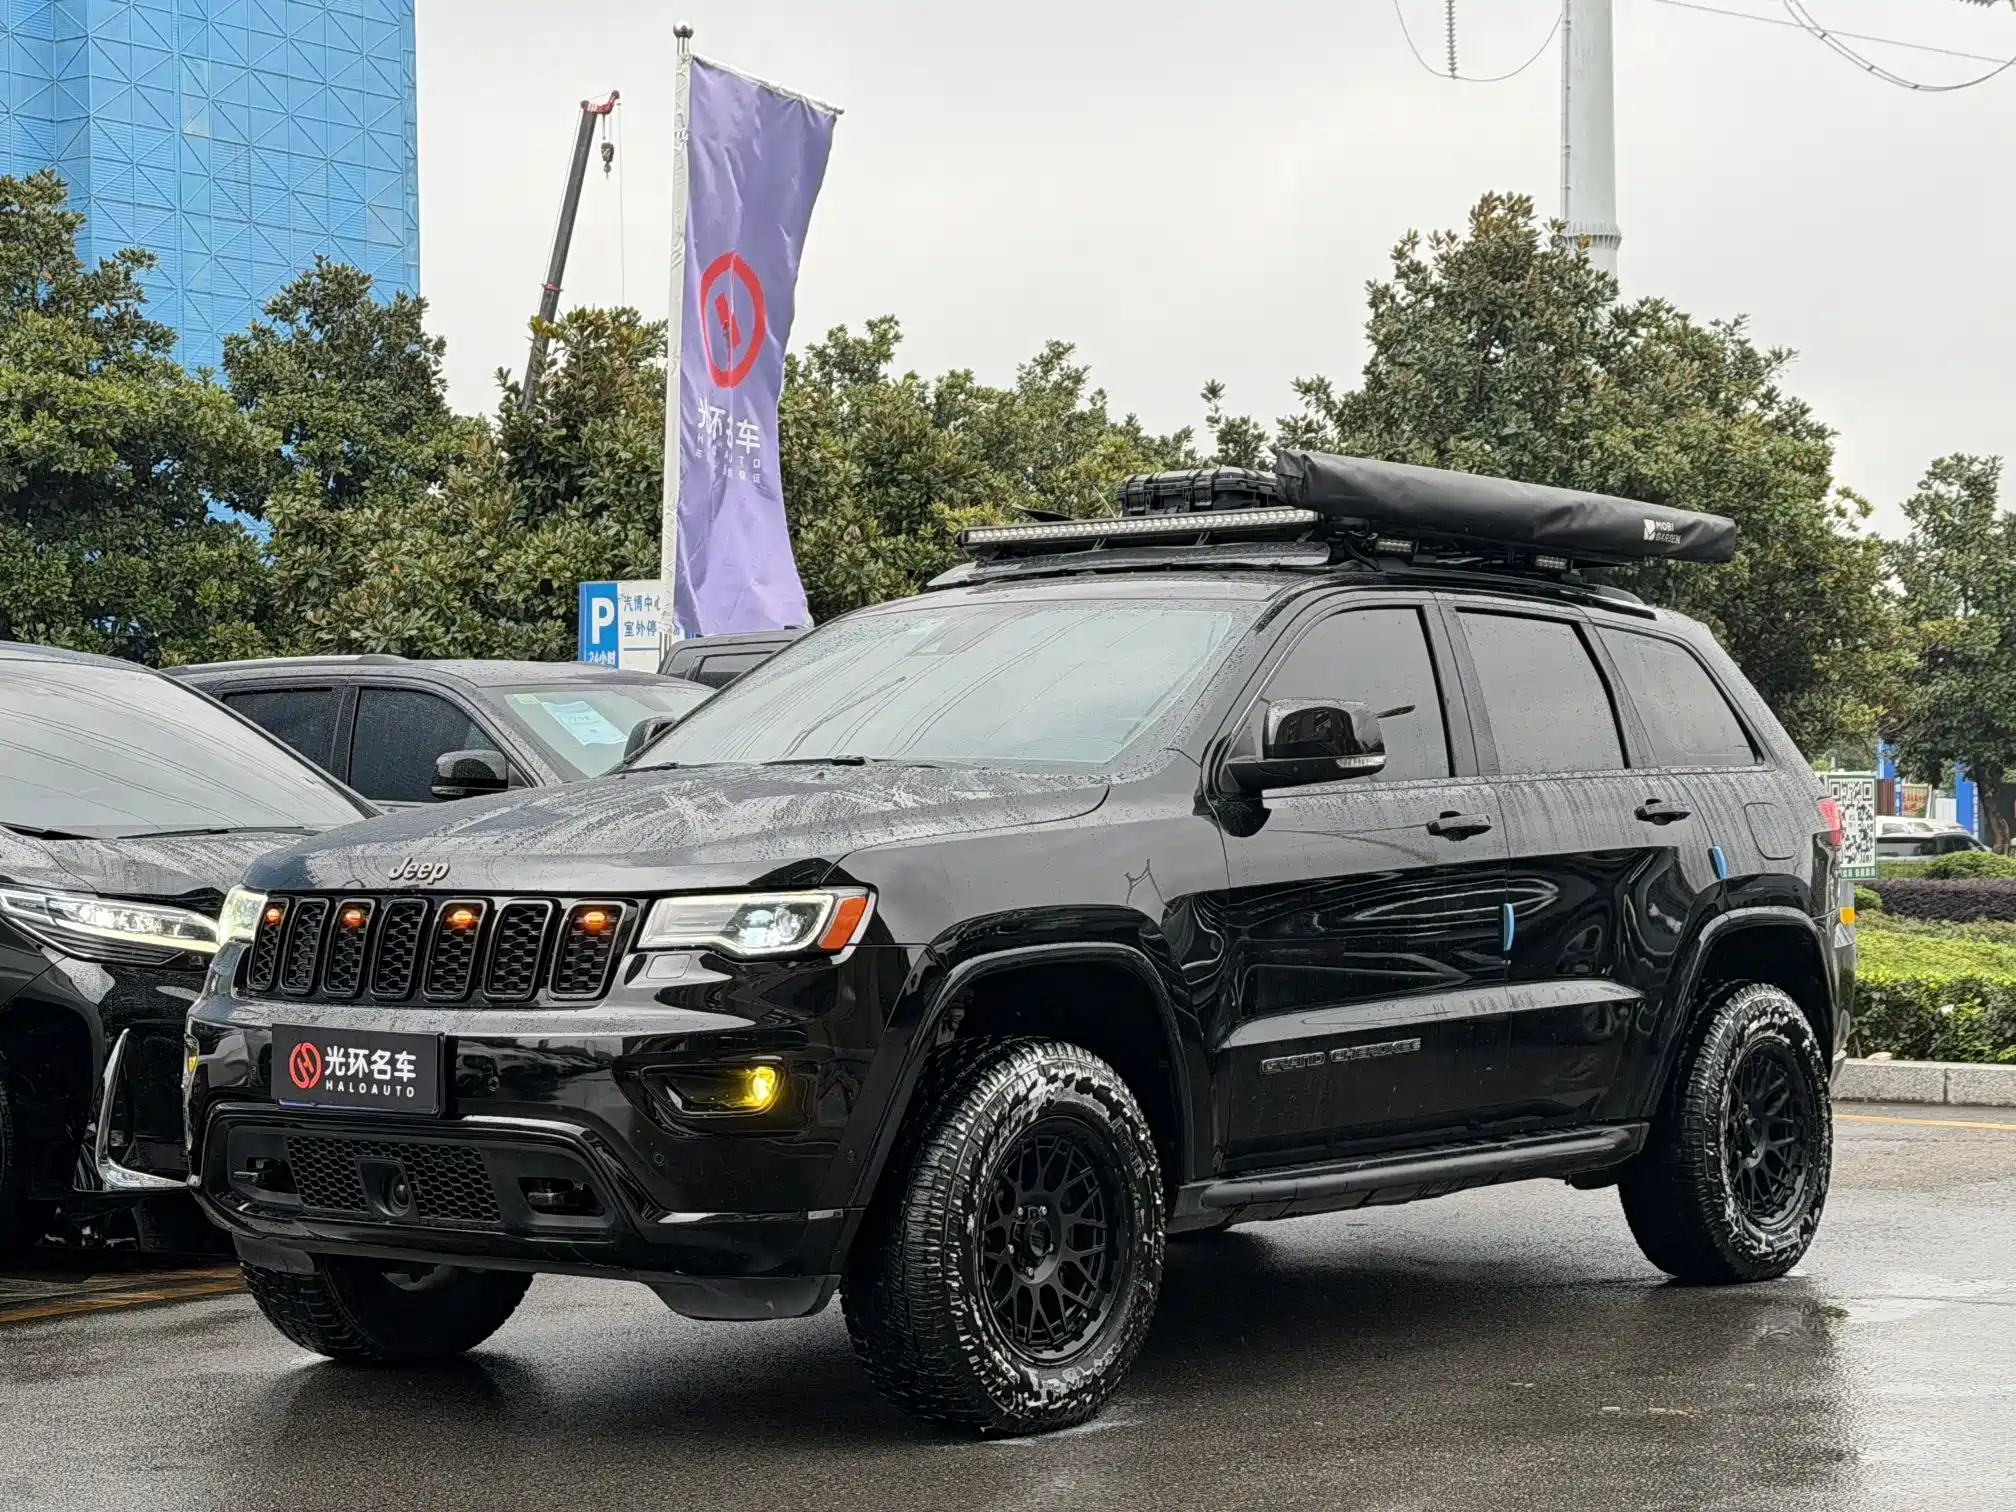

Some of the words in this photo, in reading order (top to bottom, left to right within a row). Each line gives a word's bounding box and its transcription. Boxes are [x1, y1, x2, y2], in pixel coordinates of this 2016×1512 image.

[1655, 520, 1675, 532] MOBI
[591, 597, 615, 645] P
[388, 857, 450, 885] Jeep
[324, 1045, 417, 1083] 光环名车
[325, 1080, 416, 1098] HALOAUTO
